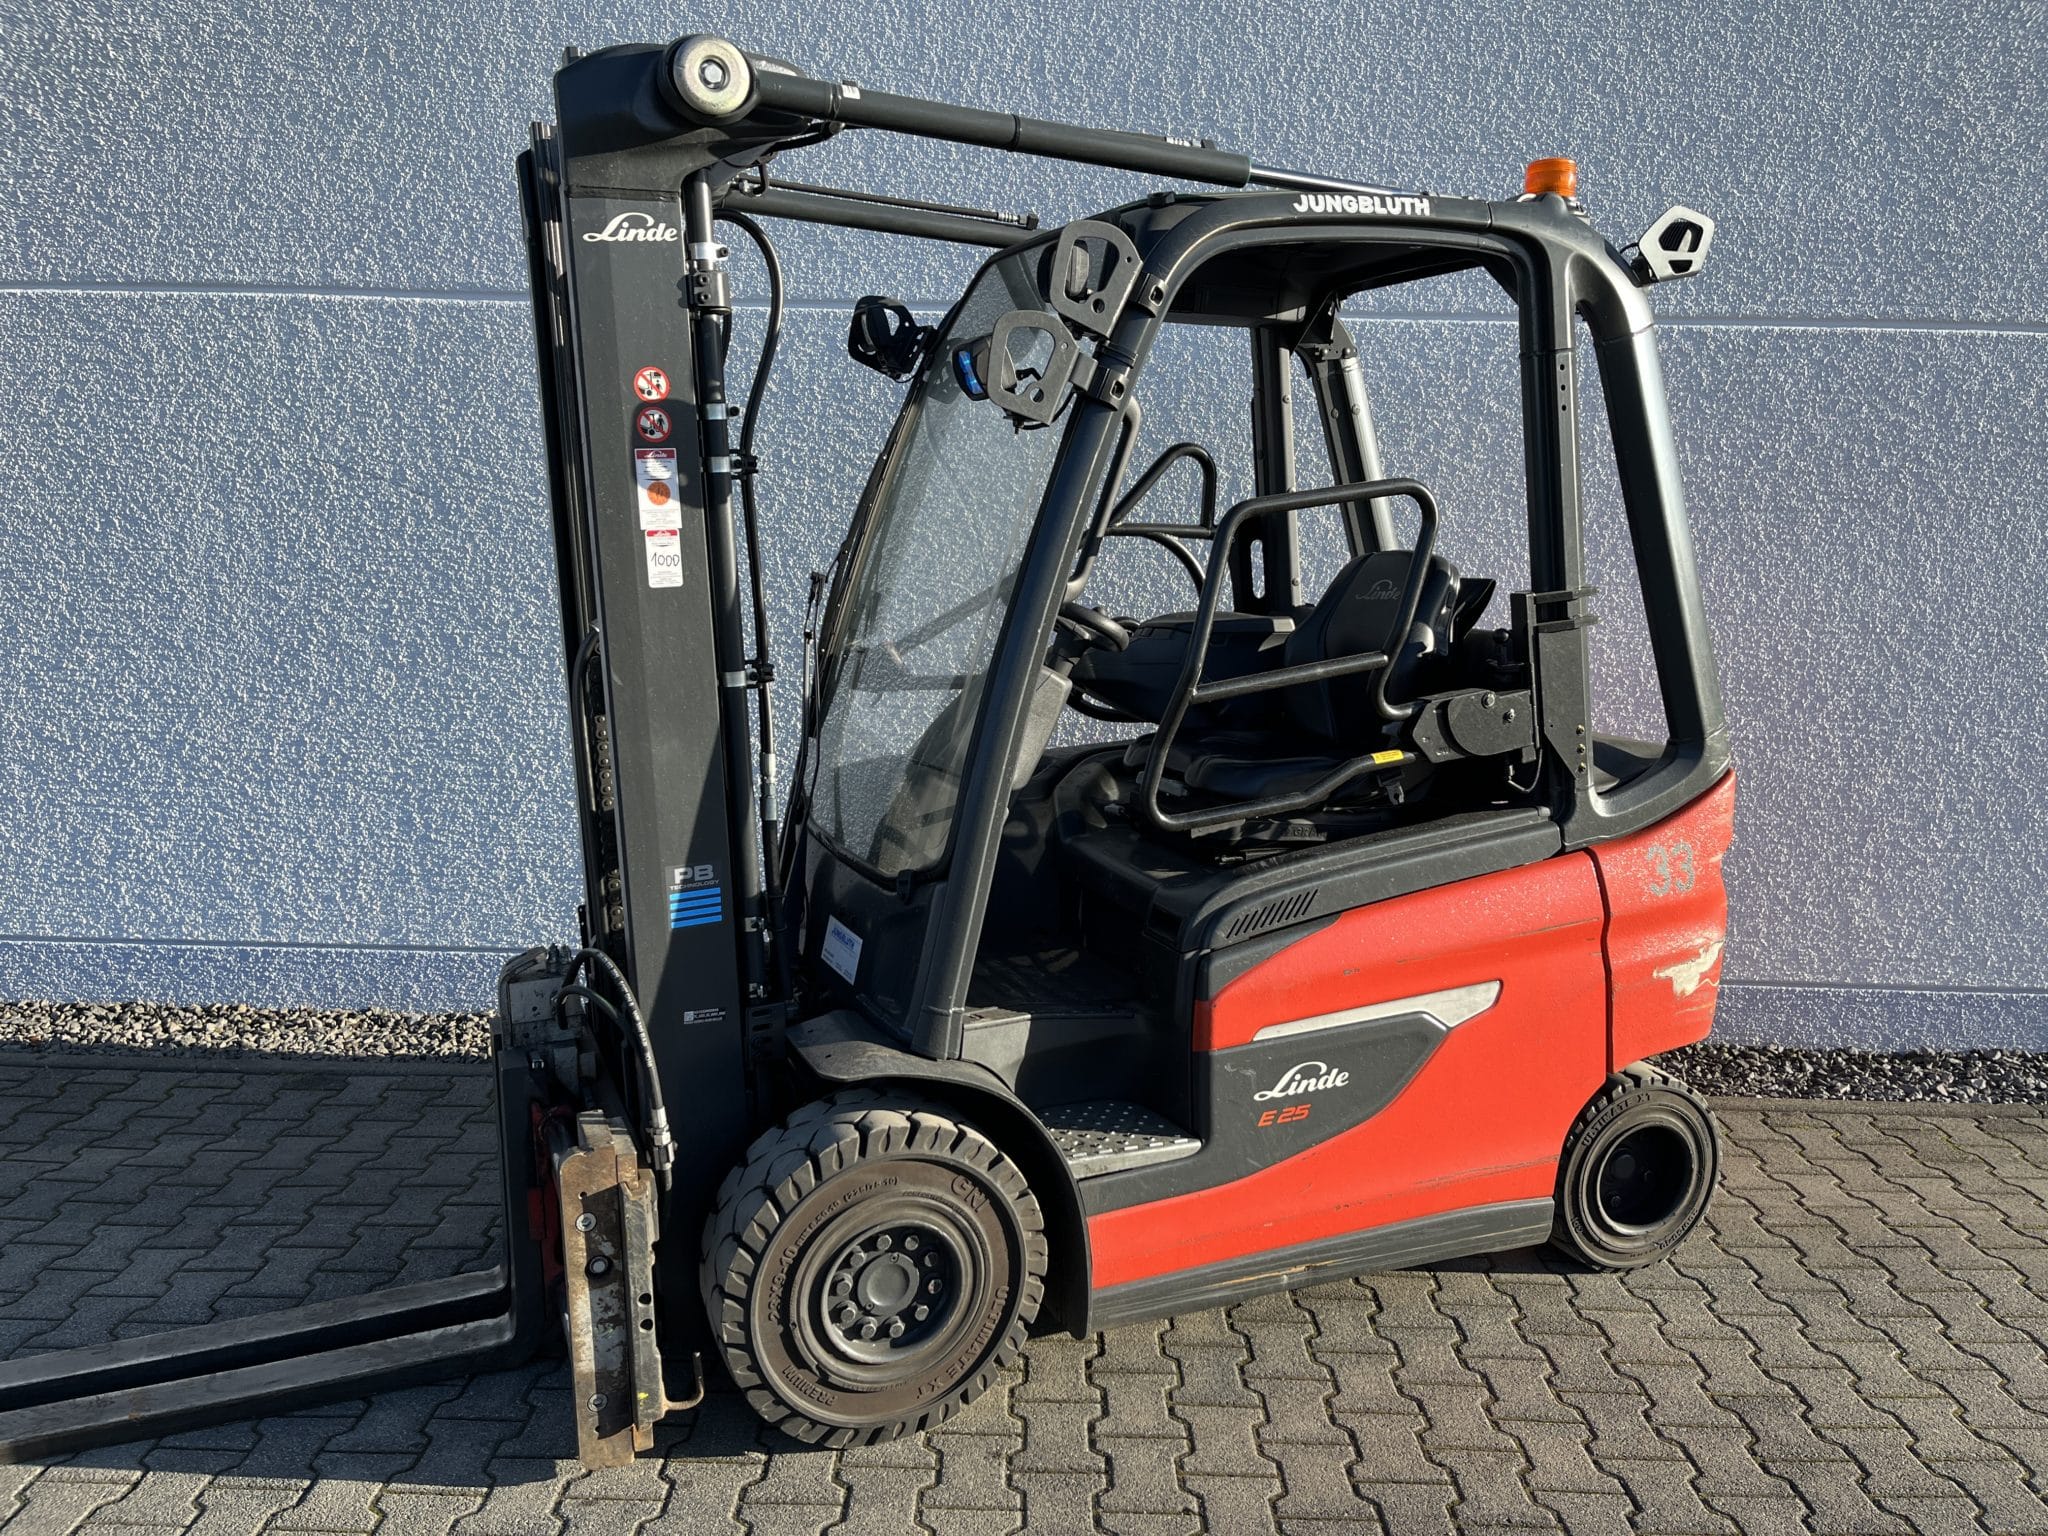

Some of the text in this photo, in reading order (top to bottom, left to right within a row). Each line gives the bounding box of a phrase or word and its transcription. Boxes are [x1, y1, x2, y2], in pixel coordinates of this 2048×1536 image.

[1293, 194, 1430, 216] JUNGBLUTH
[582, 212, 679, 242] Linde
[650, 552, 680, 567] 1000
[1355, 579, 1401, 600] Linde
[674, 865, 714, 884] PB
[1647, 842, 1694, 896] 33
[1253, 1061, 1349, 1101] Linde
[1257, 1104, 1311, 1127] E 25
[944, 1285, 1010, 1379] ULTIMATE
[781, 1364, 837, 1406] PREMIUM
